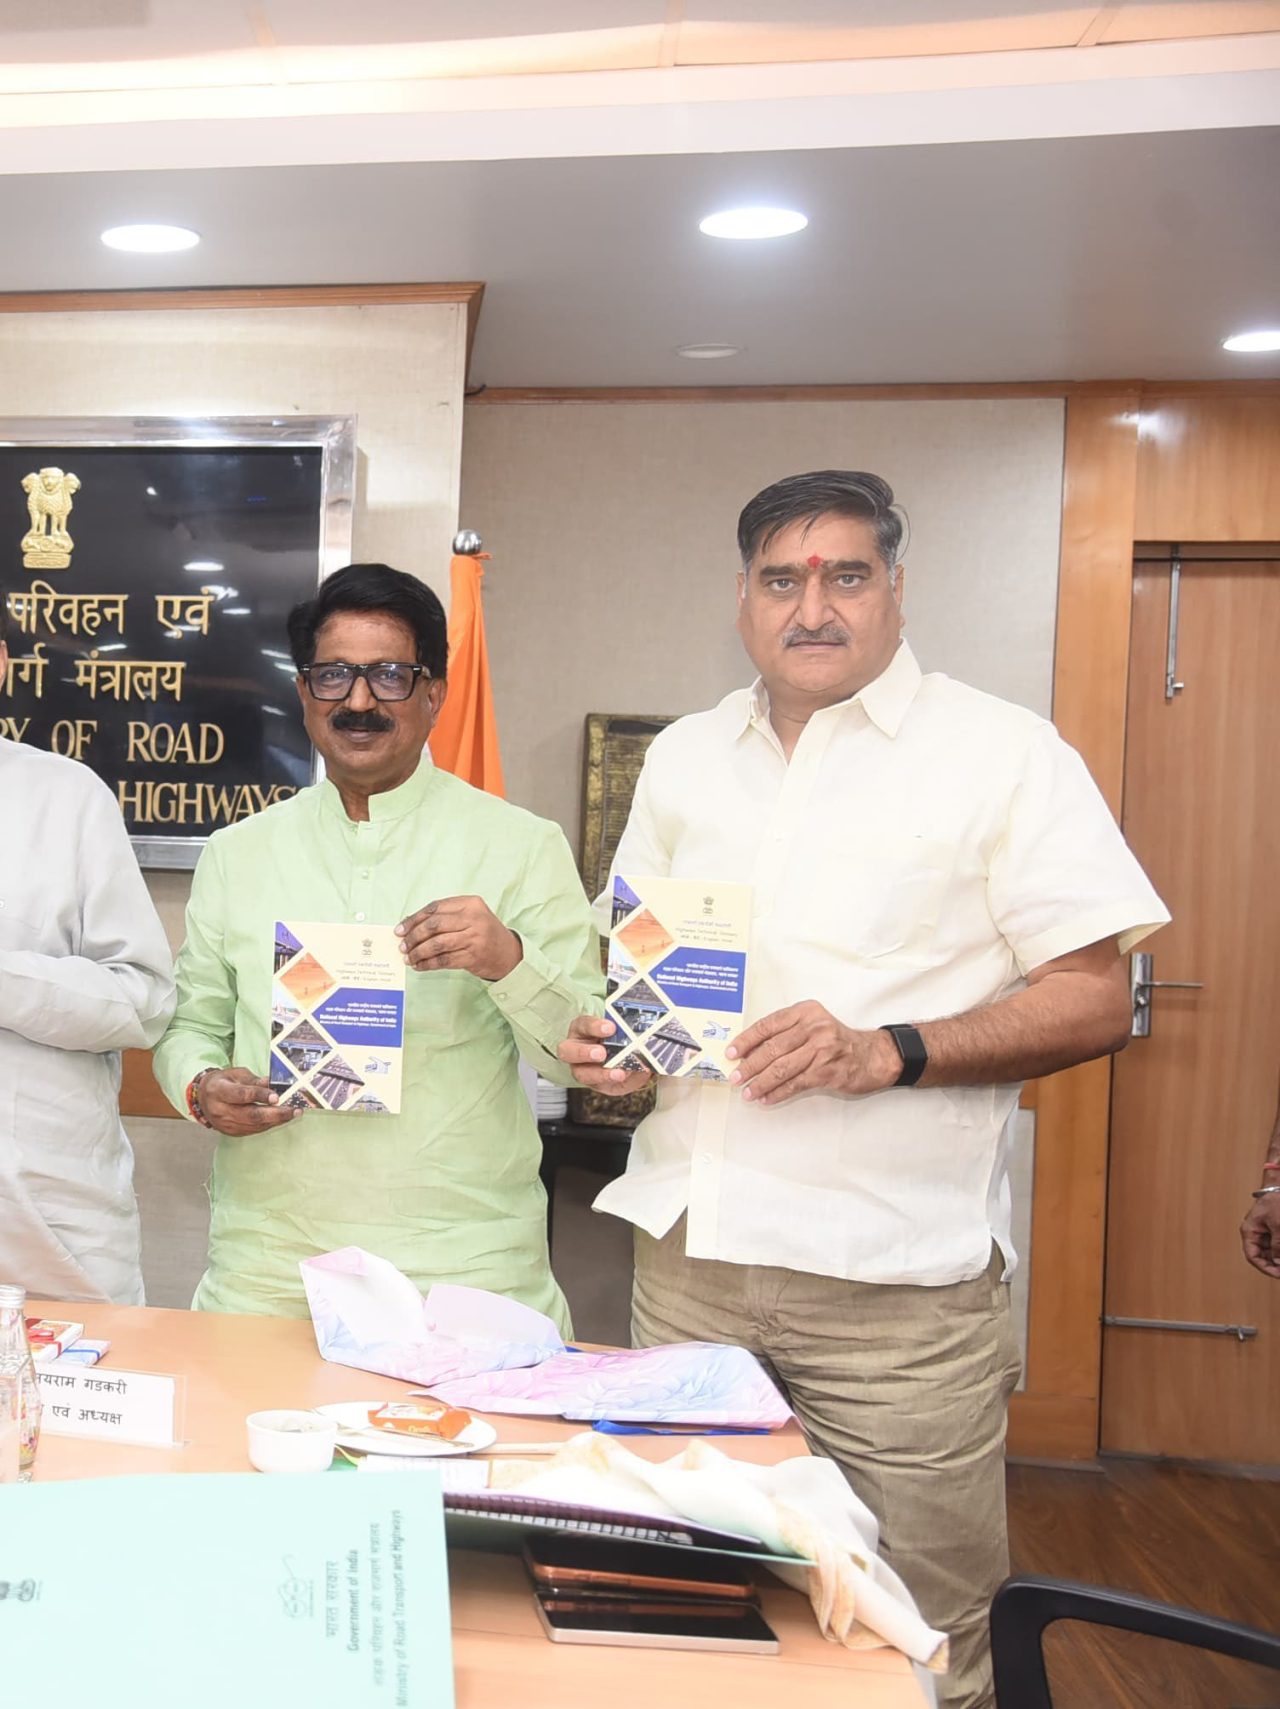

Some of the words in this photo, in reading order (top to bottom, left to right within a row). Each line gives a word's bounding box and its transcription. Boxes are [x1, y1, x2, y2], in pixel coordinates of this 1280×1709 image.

[7, 579, 129, 637] परिवहन
[155, 587, 215, 638] एवं
[74, 650, 187, 701] मंत्रालय
[51, 720, 98, 760] OF
[127, 721, 224, 764] ROAD
[84, 1378, 128, 1395] गडकरी
[52, 1402, 71, 1419] एवं
[78, 1408, 123, 1425] अध्यक्ष
[389, 1509, 406, 1552] Highways
[347, 1549, 358, 1573] India
[392, 1553, 403, 1571] and
[347, 1576, 358, 1587] of
[392, 1572, 408, 1617] Transport
[347, 1588, 360, 1652] Government
[393, 1619, 406, 1646] Road
[394, 1649, 407, 1660] of
[395, 1662, 410, 1707] Ministry
